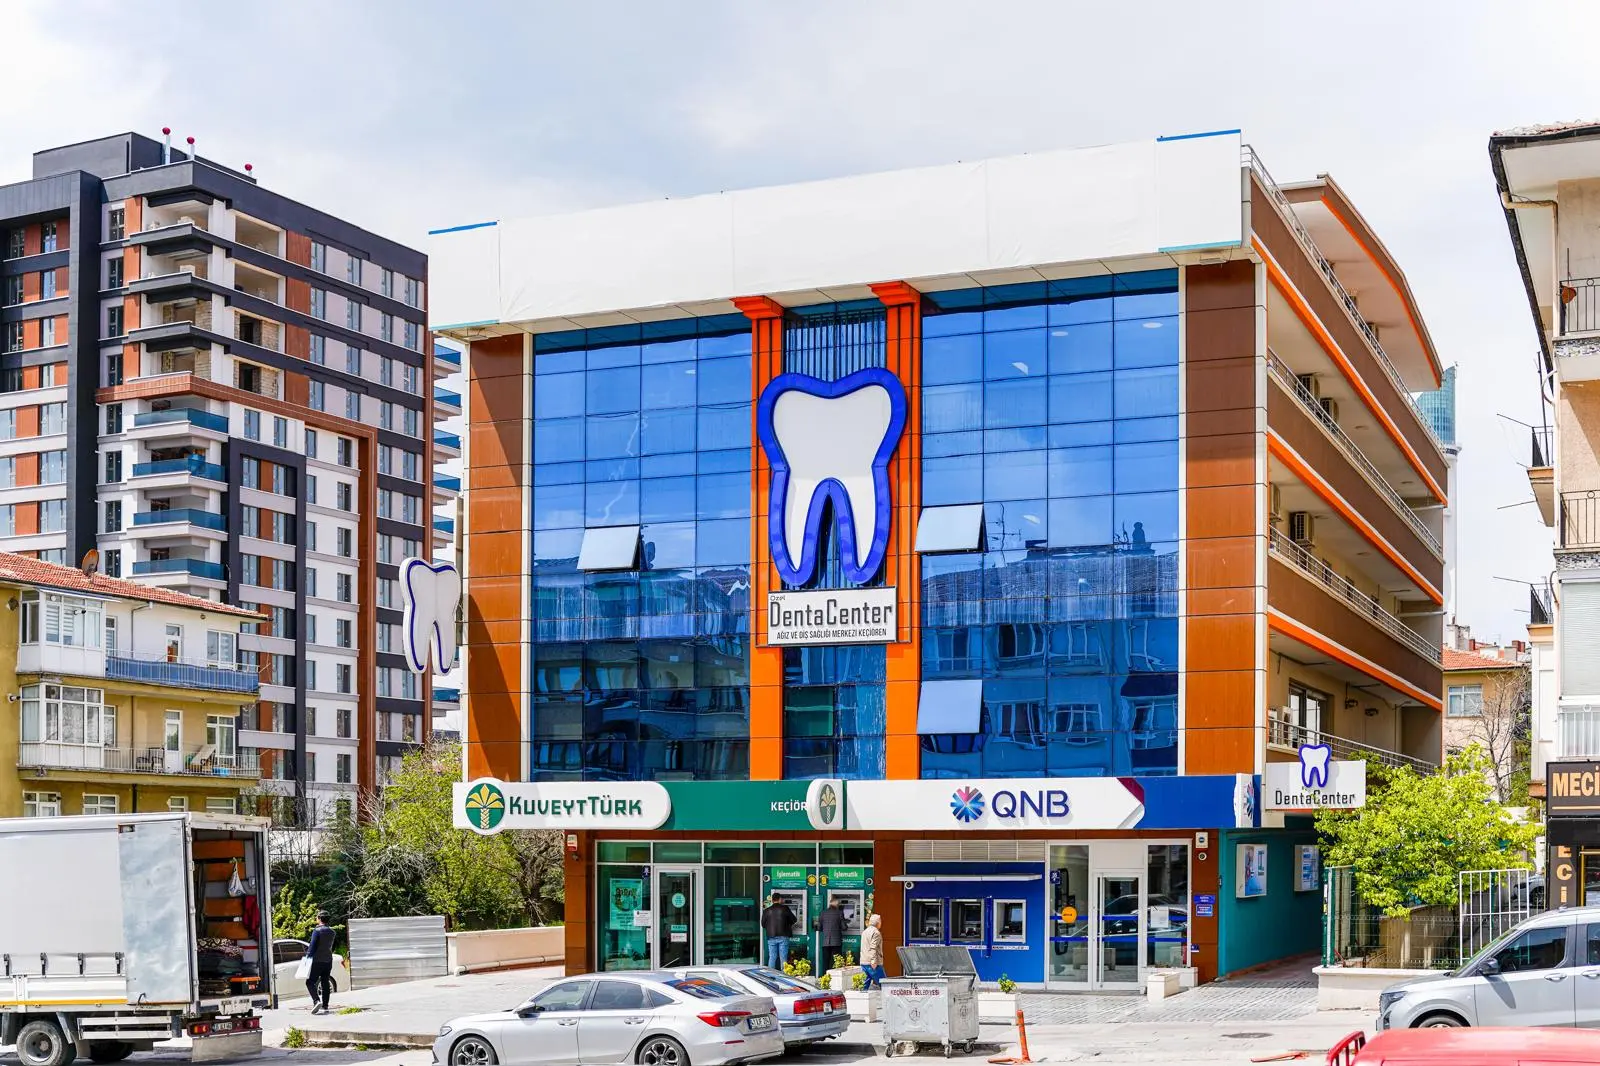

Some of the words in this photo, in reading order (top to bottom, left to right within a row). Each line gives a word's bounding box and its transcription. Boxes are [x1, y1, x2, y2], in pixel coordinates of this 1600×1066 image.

[770, 599, 893, 627] DentaCenter
[777, 631, 790, 640] AĞIZ
[791, 631, 799, 639] VE
[991, 789, 1070, 819] QNB
[1275, 789, 1355, 805] DentaCenter
